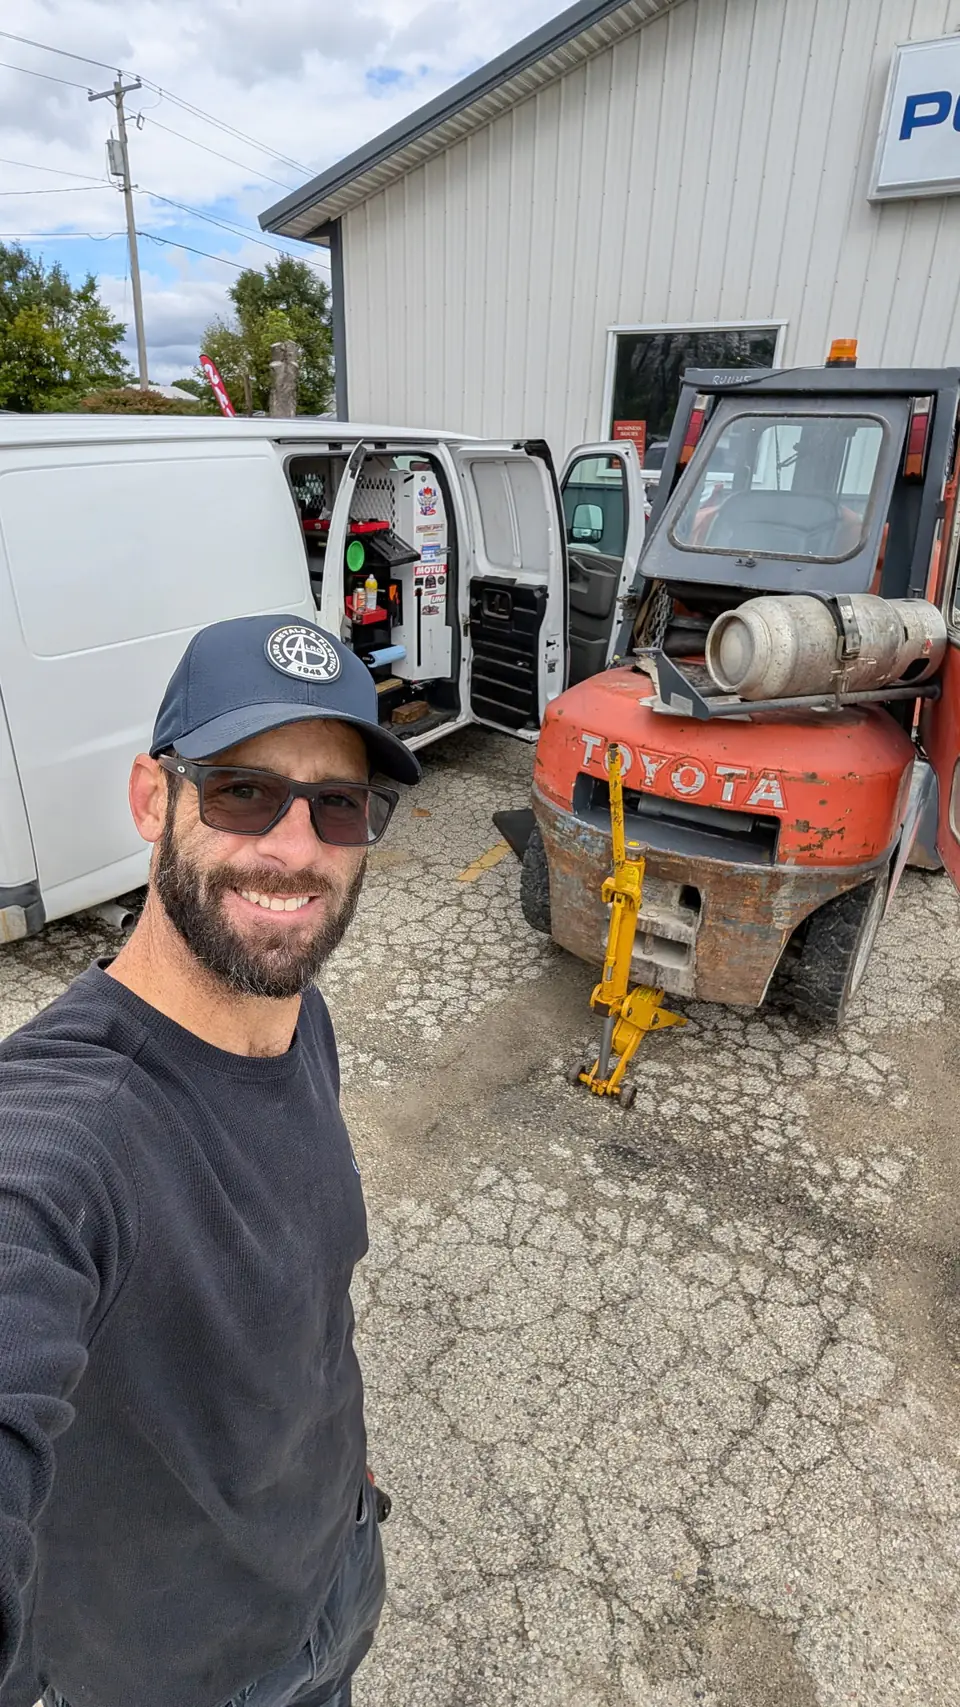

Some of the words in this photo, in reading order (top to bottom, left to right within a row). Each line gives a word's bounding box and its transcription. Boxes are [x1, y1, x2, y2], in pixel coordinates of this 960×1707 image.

[899, 91, 960, 140] P
[415, 565, 446, 575] MOTUL
[274, 628, 307, 643] METALS
[272, 643, 287, 663] ALRO
[318, 639, 336, 673] PLASTICS
[296, 665, 322, 676] 1948
[581, 733, 785, 809] TOYOTA
